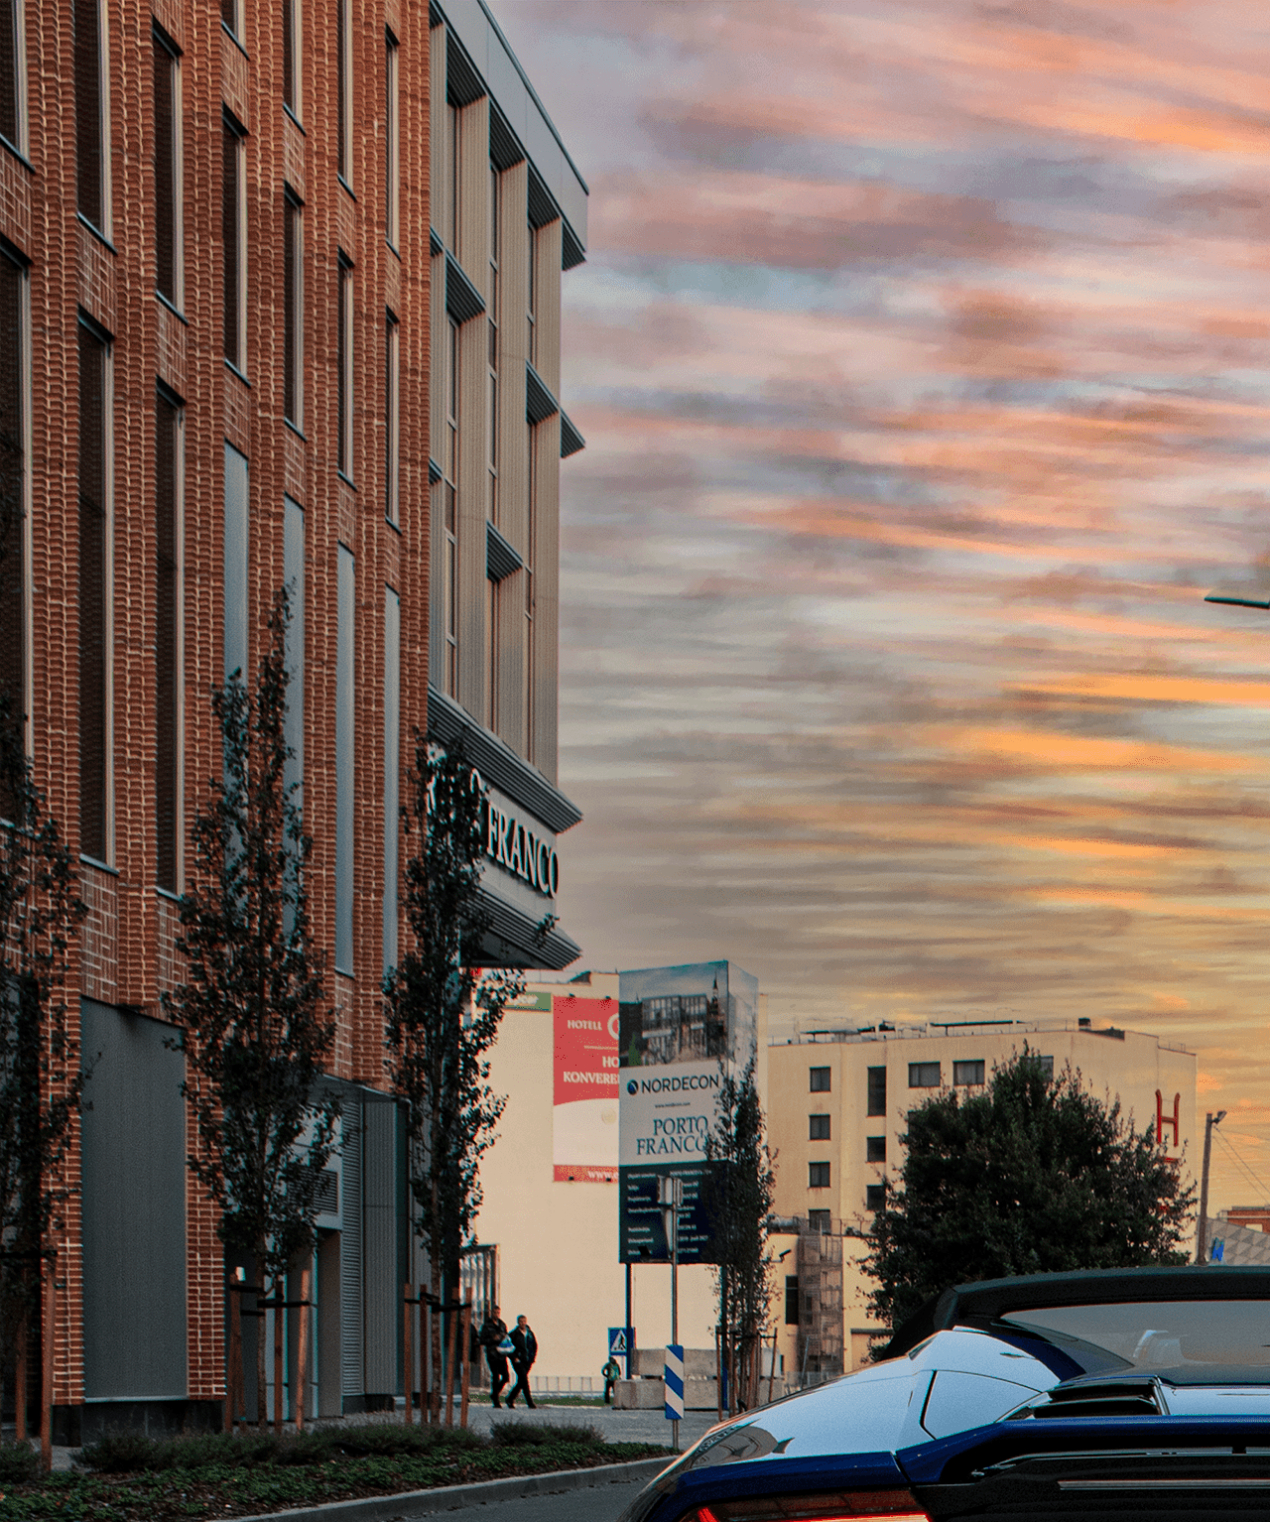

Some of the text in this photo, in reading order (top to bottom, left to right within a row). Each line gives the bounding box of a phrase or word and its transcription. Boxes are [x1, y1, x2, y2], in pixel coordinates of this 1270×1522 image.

[487, 802, 560, 899] FRANCO
[567, 1019, 602, 1031] HOTELL
[563, 1071, 620, 1085] KONVERE
[641, 1074, 719, 1094] NORDECON
[653, 1115, 709, 1136] PORTO
[636, 1135, 707, 1156] FRANCO
